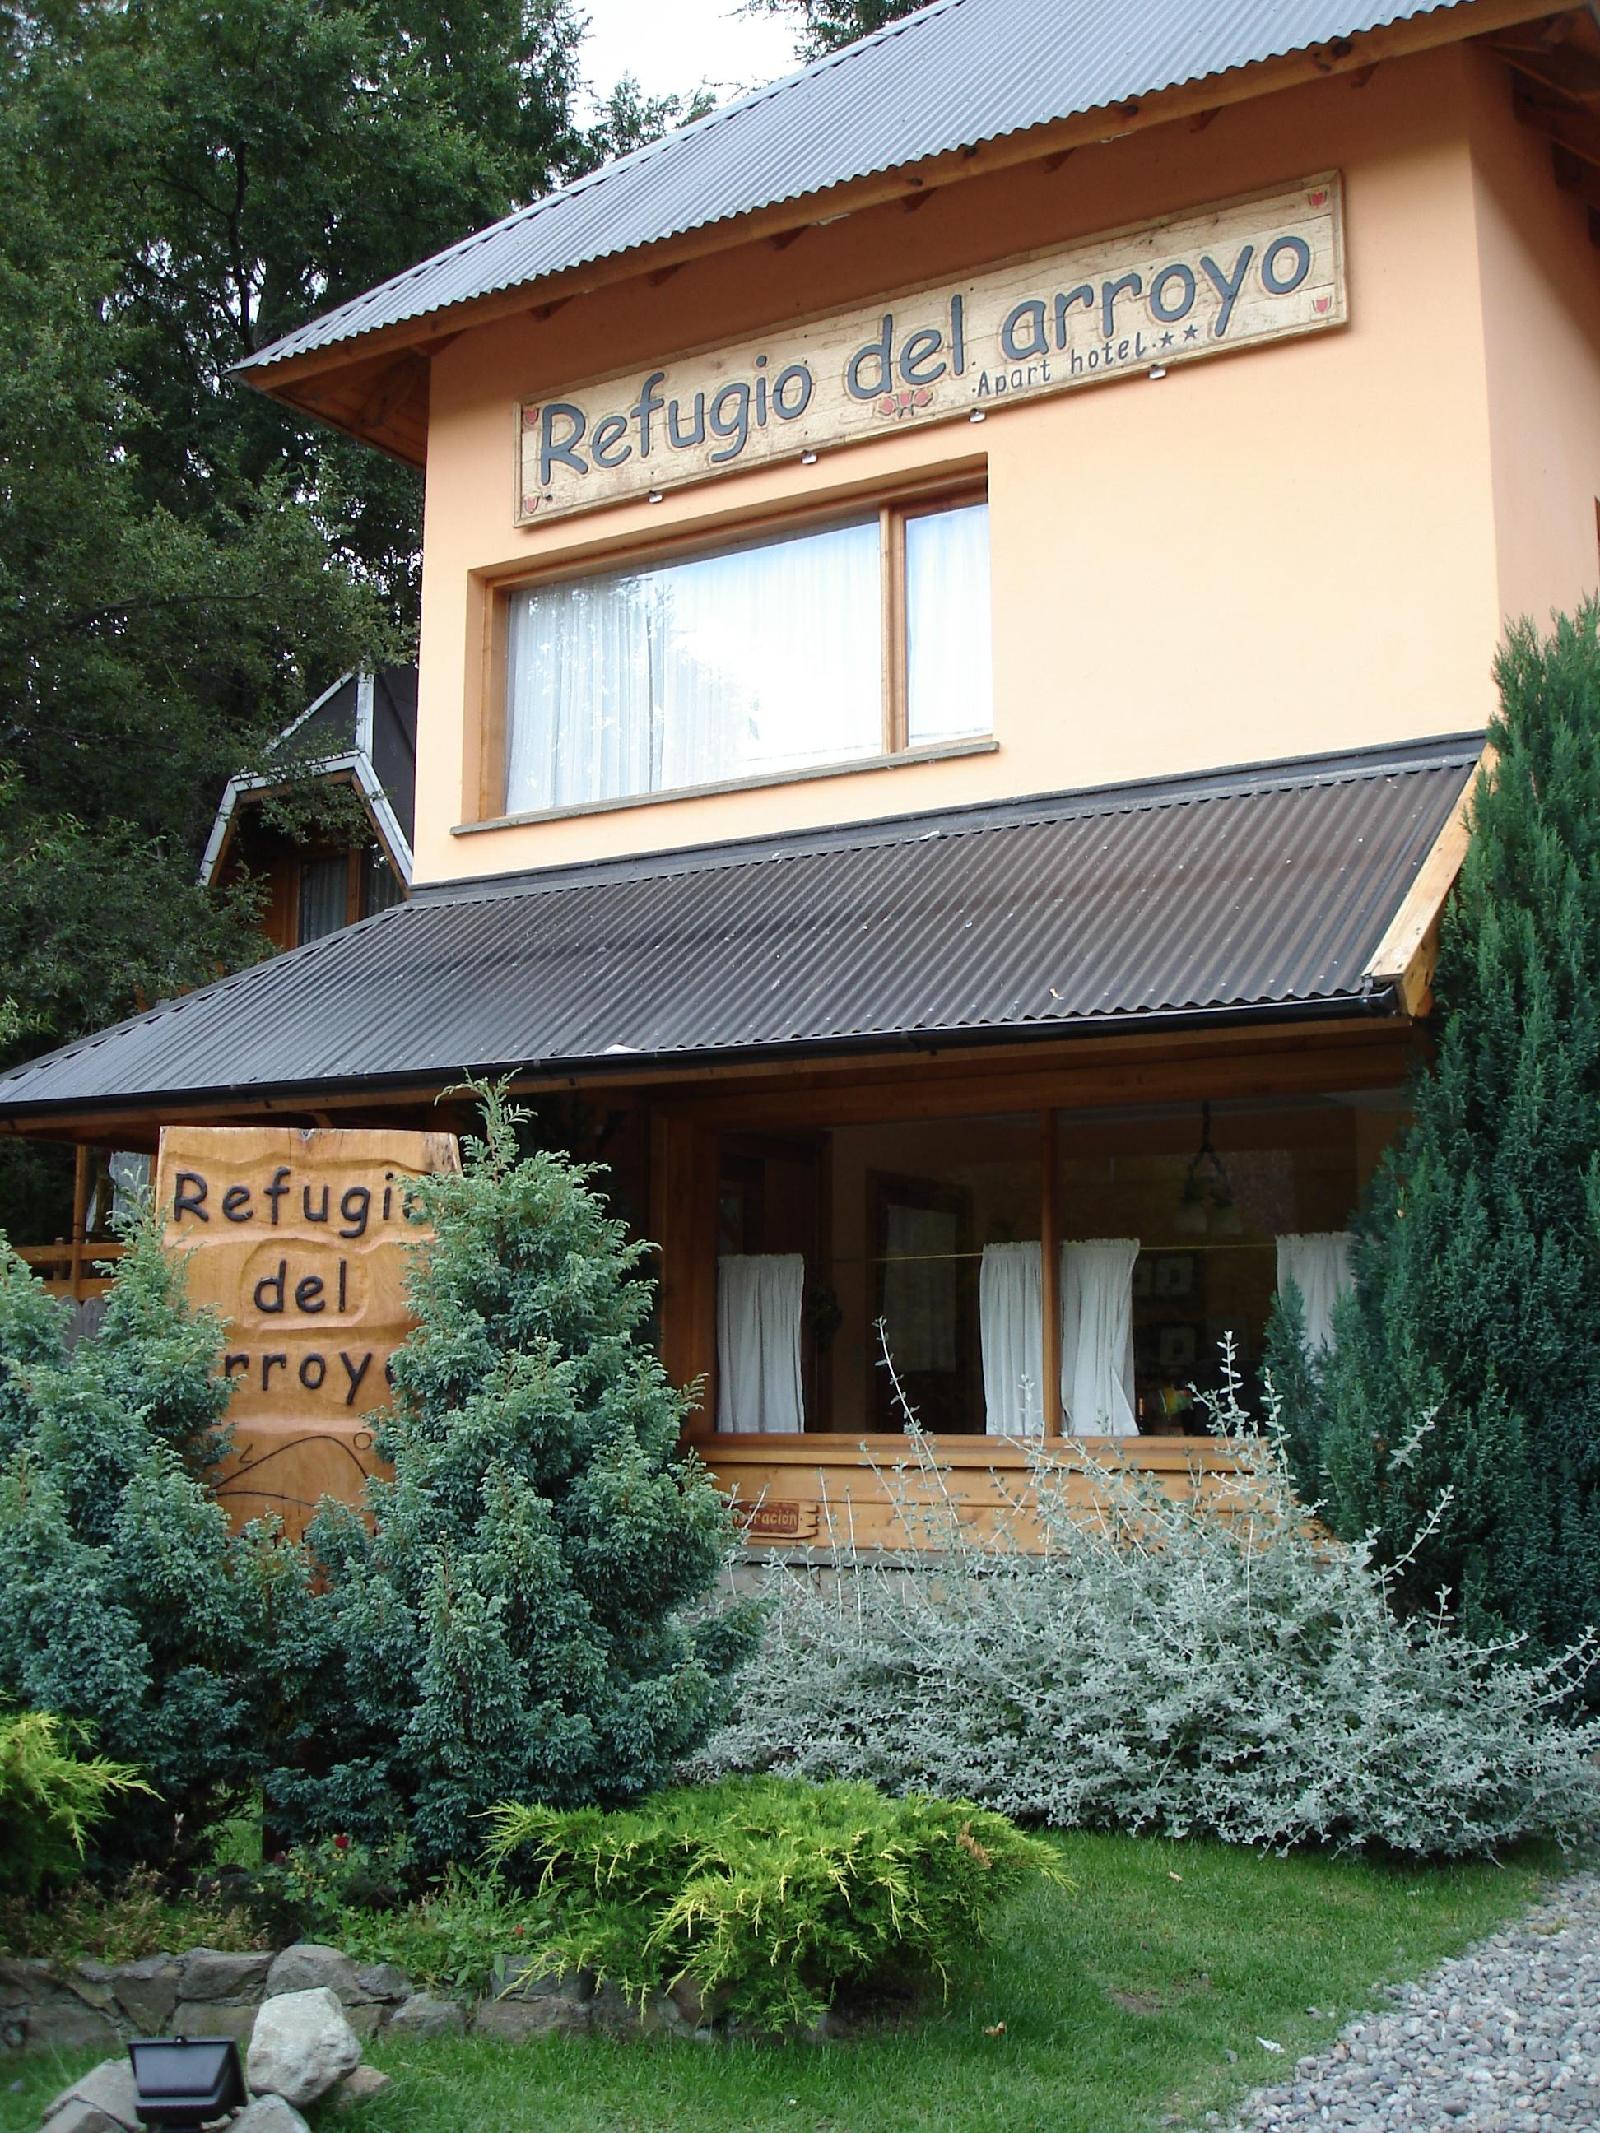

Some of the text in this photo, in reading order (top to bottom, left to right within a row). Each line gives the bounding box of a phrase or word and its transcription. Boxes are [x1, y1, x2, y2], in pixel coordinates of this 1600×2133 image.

[540, 235, 1310, 486] Refugio del arroyo
[977, 359, 1051, 398] Apart
[253, 1258, 348, 1314] del
[224, 1352, 398, 1406] rroy
